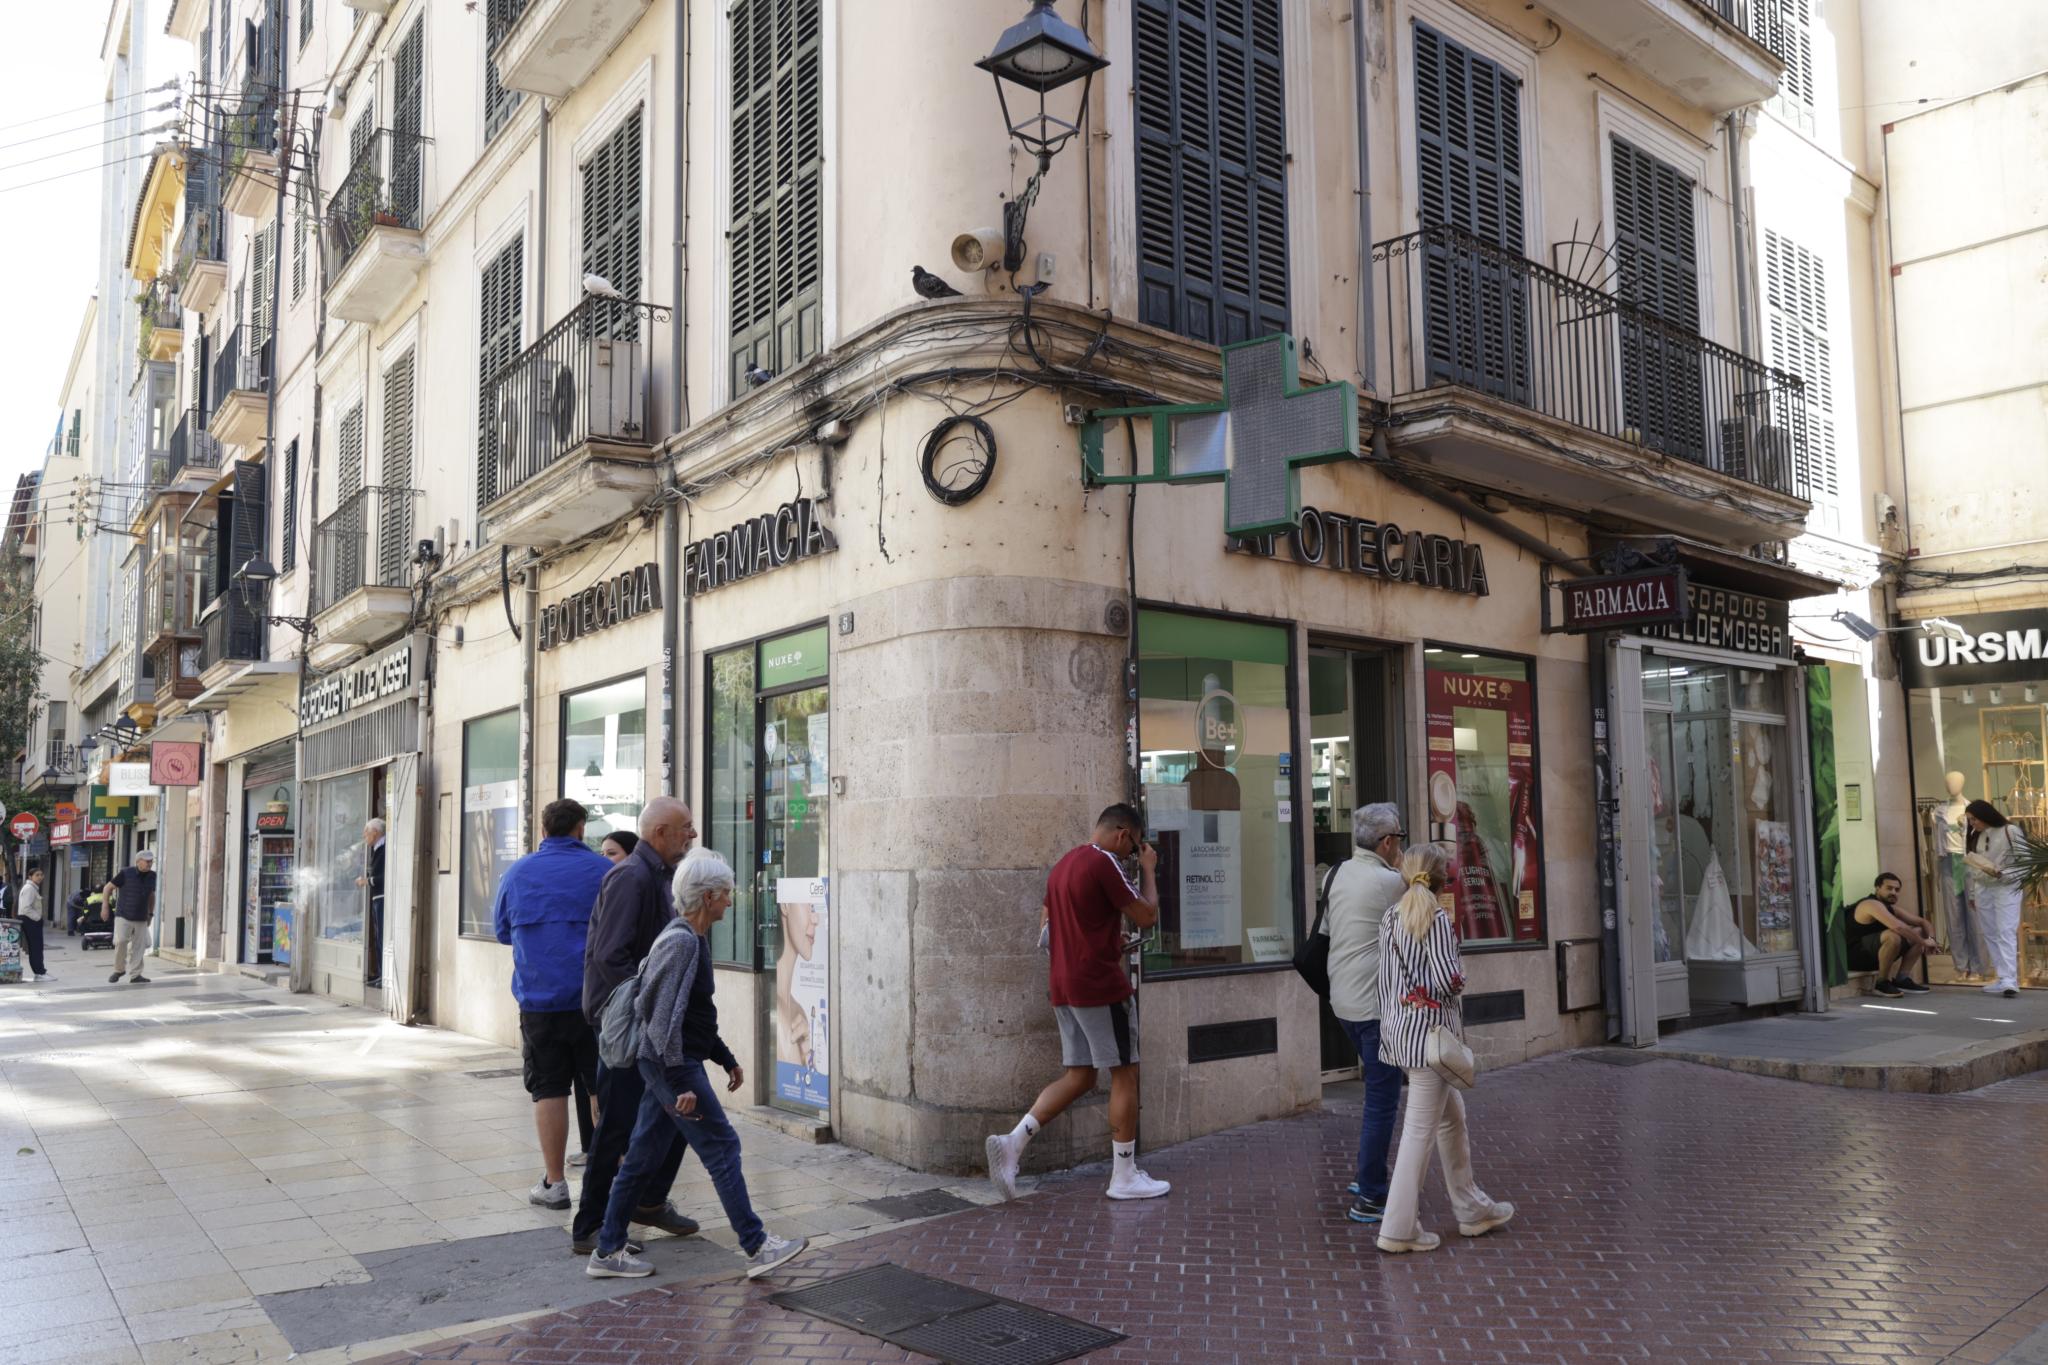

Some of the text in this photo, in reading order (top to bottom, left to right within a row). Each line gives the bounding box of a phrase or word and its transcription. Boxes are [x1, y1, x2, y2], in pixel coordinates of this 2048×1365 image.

[684, 498, 837, 597] FARMACIA
[537, 562, 662, 652] APOTECARIA
[1573, 580, 1670, 619] FARMACIA
[1687, 585, 1767, 622] RDADOS
[841, 615, 849, 631] 5
[1642, 612, 1783, 656] LLDEMOSSA
[768, 653, 793, 669] NUXE
[1918, 627, 2048, 668] URSM
[301, 645, 411, 728] BORDADOS VALLDEMOSSA
[1443, 676, 1498, 699] NUXE
[258, 816, 286, 827] OPEN
[1185, 874, 1214, 884] RETINOL
[1252, 935, 1285, 944] FARMACIA
